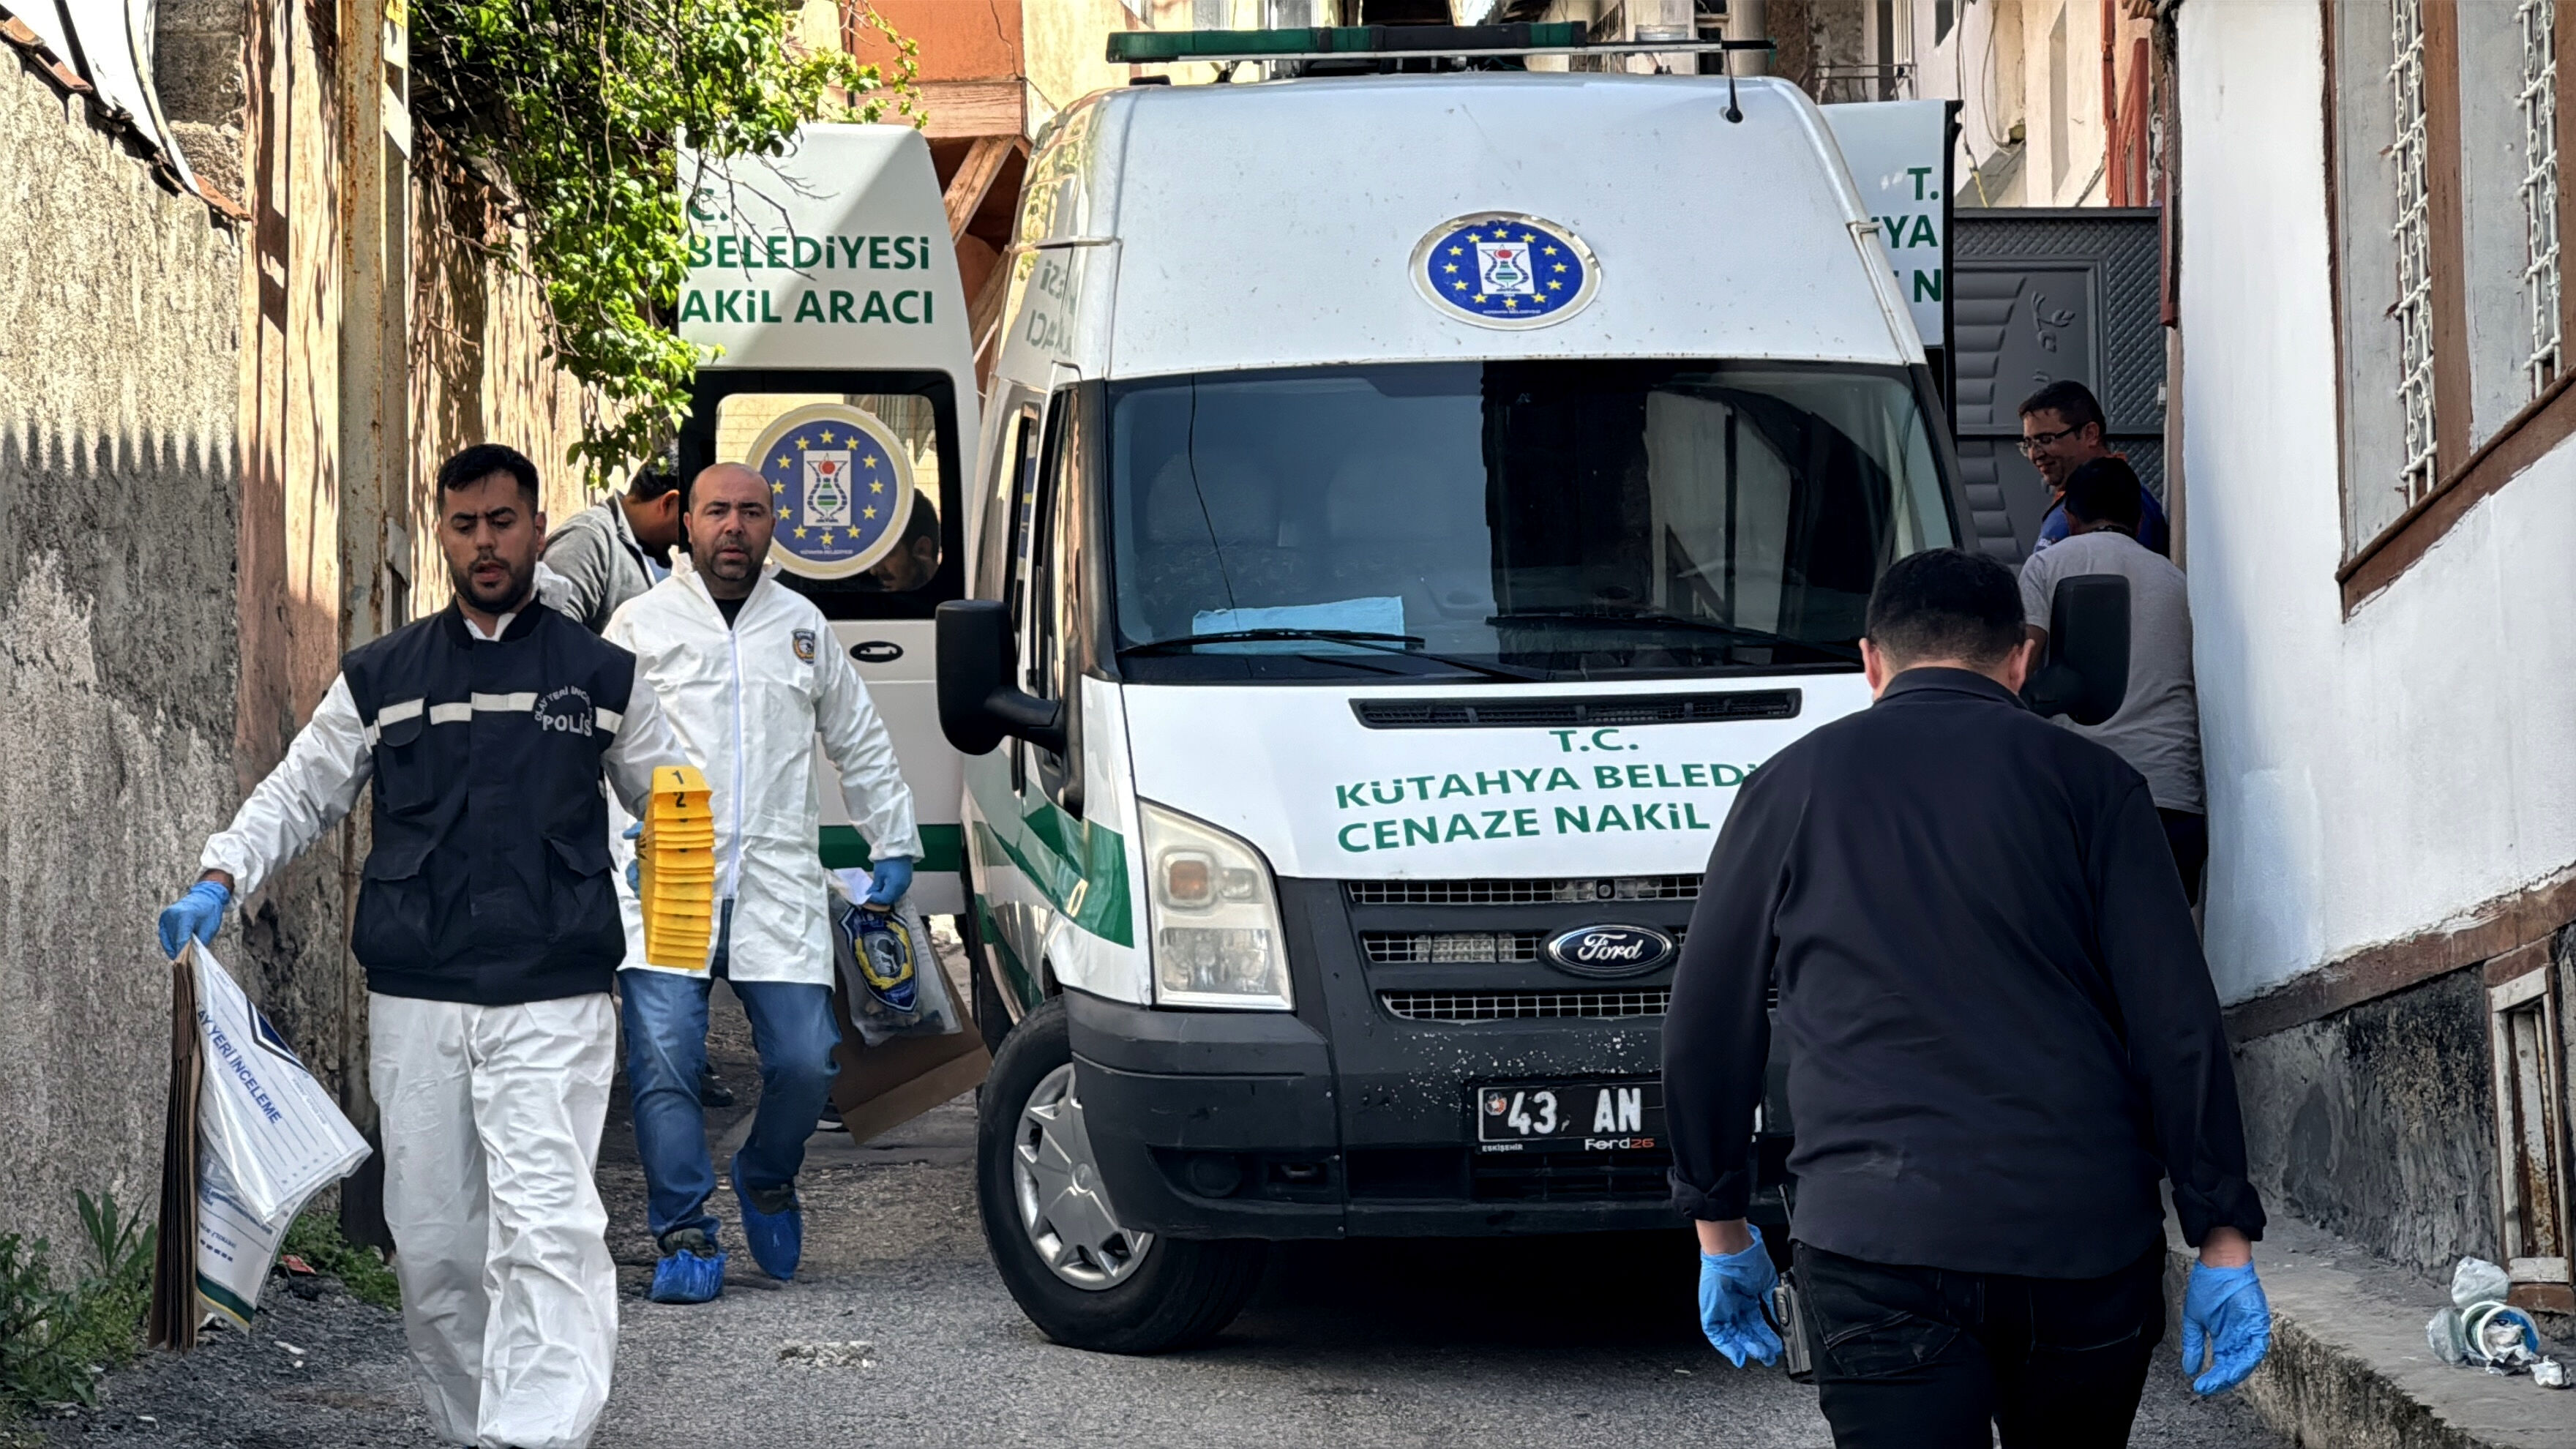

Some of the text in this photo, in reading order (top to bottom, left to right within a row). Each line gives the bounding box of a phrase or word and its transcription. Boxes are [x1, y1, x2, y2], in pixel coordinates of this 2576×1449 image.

[1907, 167, 1939, 200] T.
[794, 290, 933, 324] ARACI
[542, 712, 593, 737] POLİS
[1549, 729, 1639, 752] T.C.
[672, 770, 684, 785] 1
[1336, 767, 1581, 809] KÜTAHYA
[673, 792, 687, 808] 2
[1337, 808, 1540, 853] CENAZE
[1578, 933, 1644, 960] Ford
[198, 1010, 283, 1125] AY YERİ İNCELEME
[1508, 1087, 1642, 1135] 43 AN
